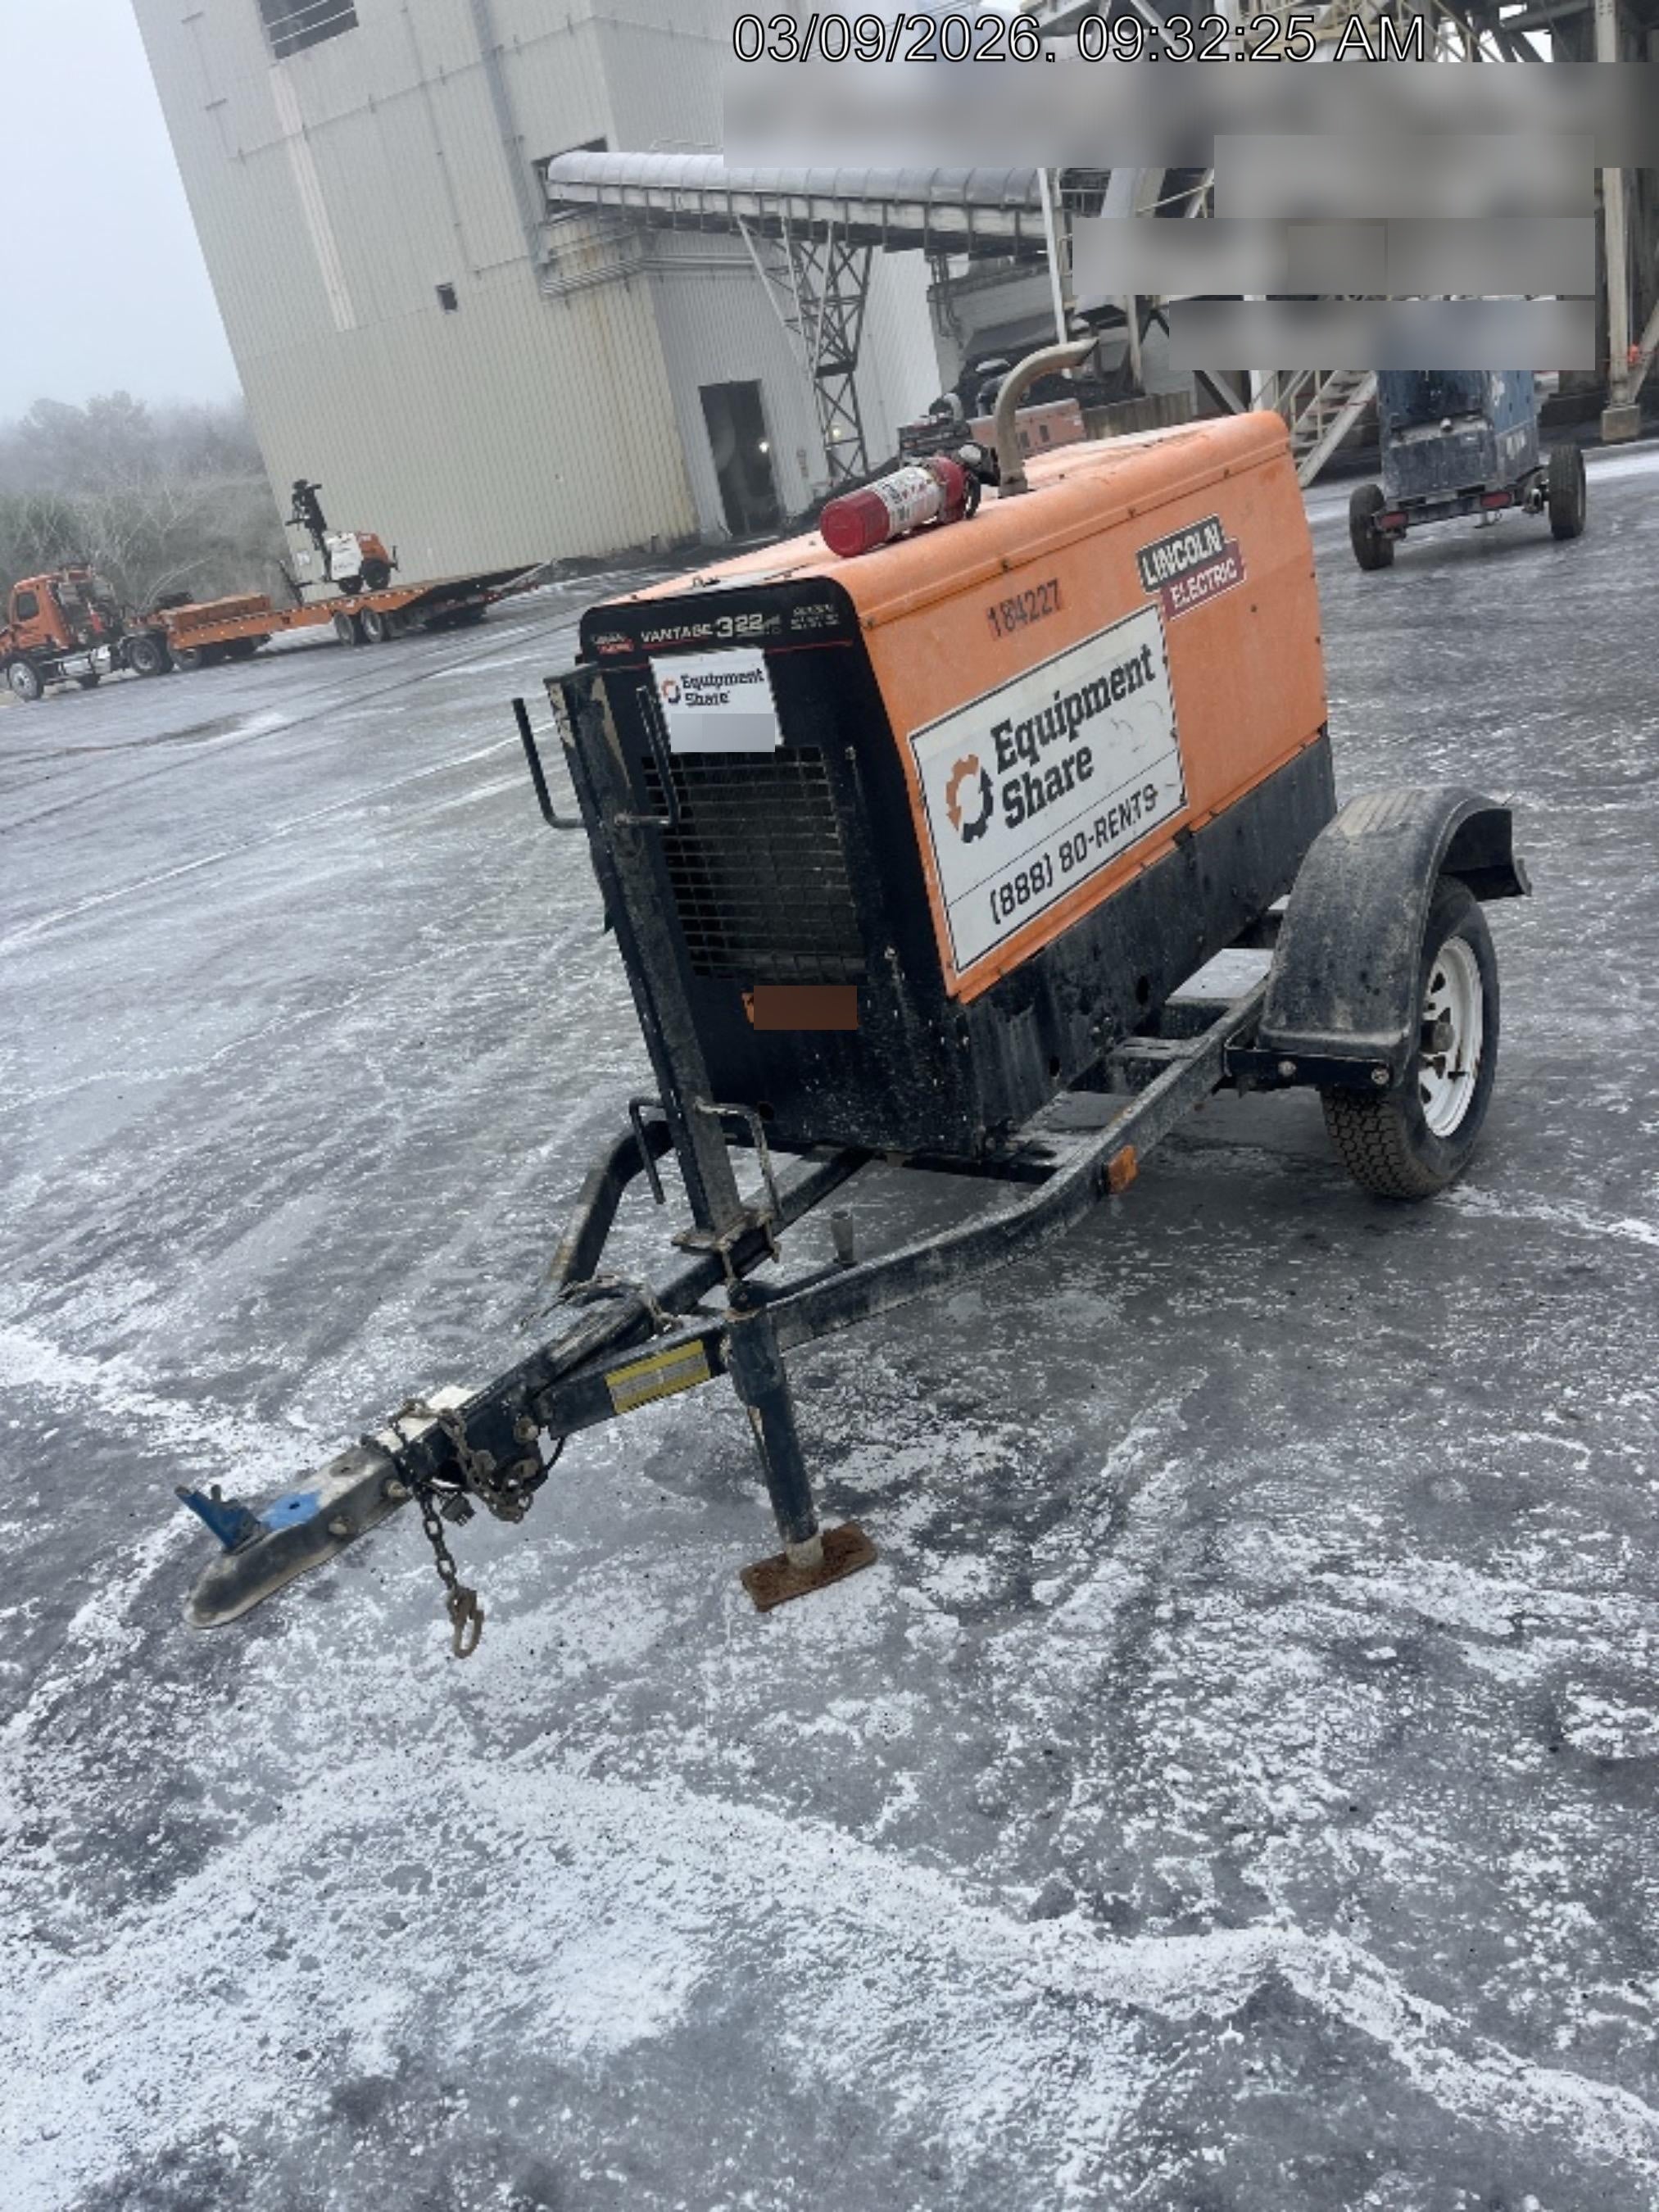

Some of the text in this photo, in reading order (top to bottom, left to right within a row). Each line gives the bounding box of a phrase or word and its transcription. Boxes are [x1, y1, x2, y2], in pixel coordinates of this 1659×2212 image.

[1141, 522, 1223, 587] LINCOLN
[1169, 558, 1238, 609] ELECTRIC
[641, 623, 713, 643] VANTAGE
[715, 613, 763, 637] 322
[987, 578, 1061, 637] 184227
[681, 668, 765, 691] Equipment
[990, 644, 1157, 775] Equipment
[1002, 746, 1095, 829] Share
[990, 782, 1159, 925] (888) 80-RENTS
